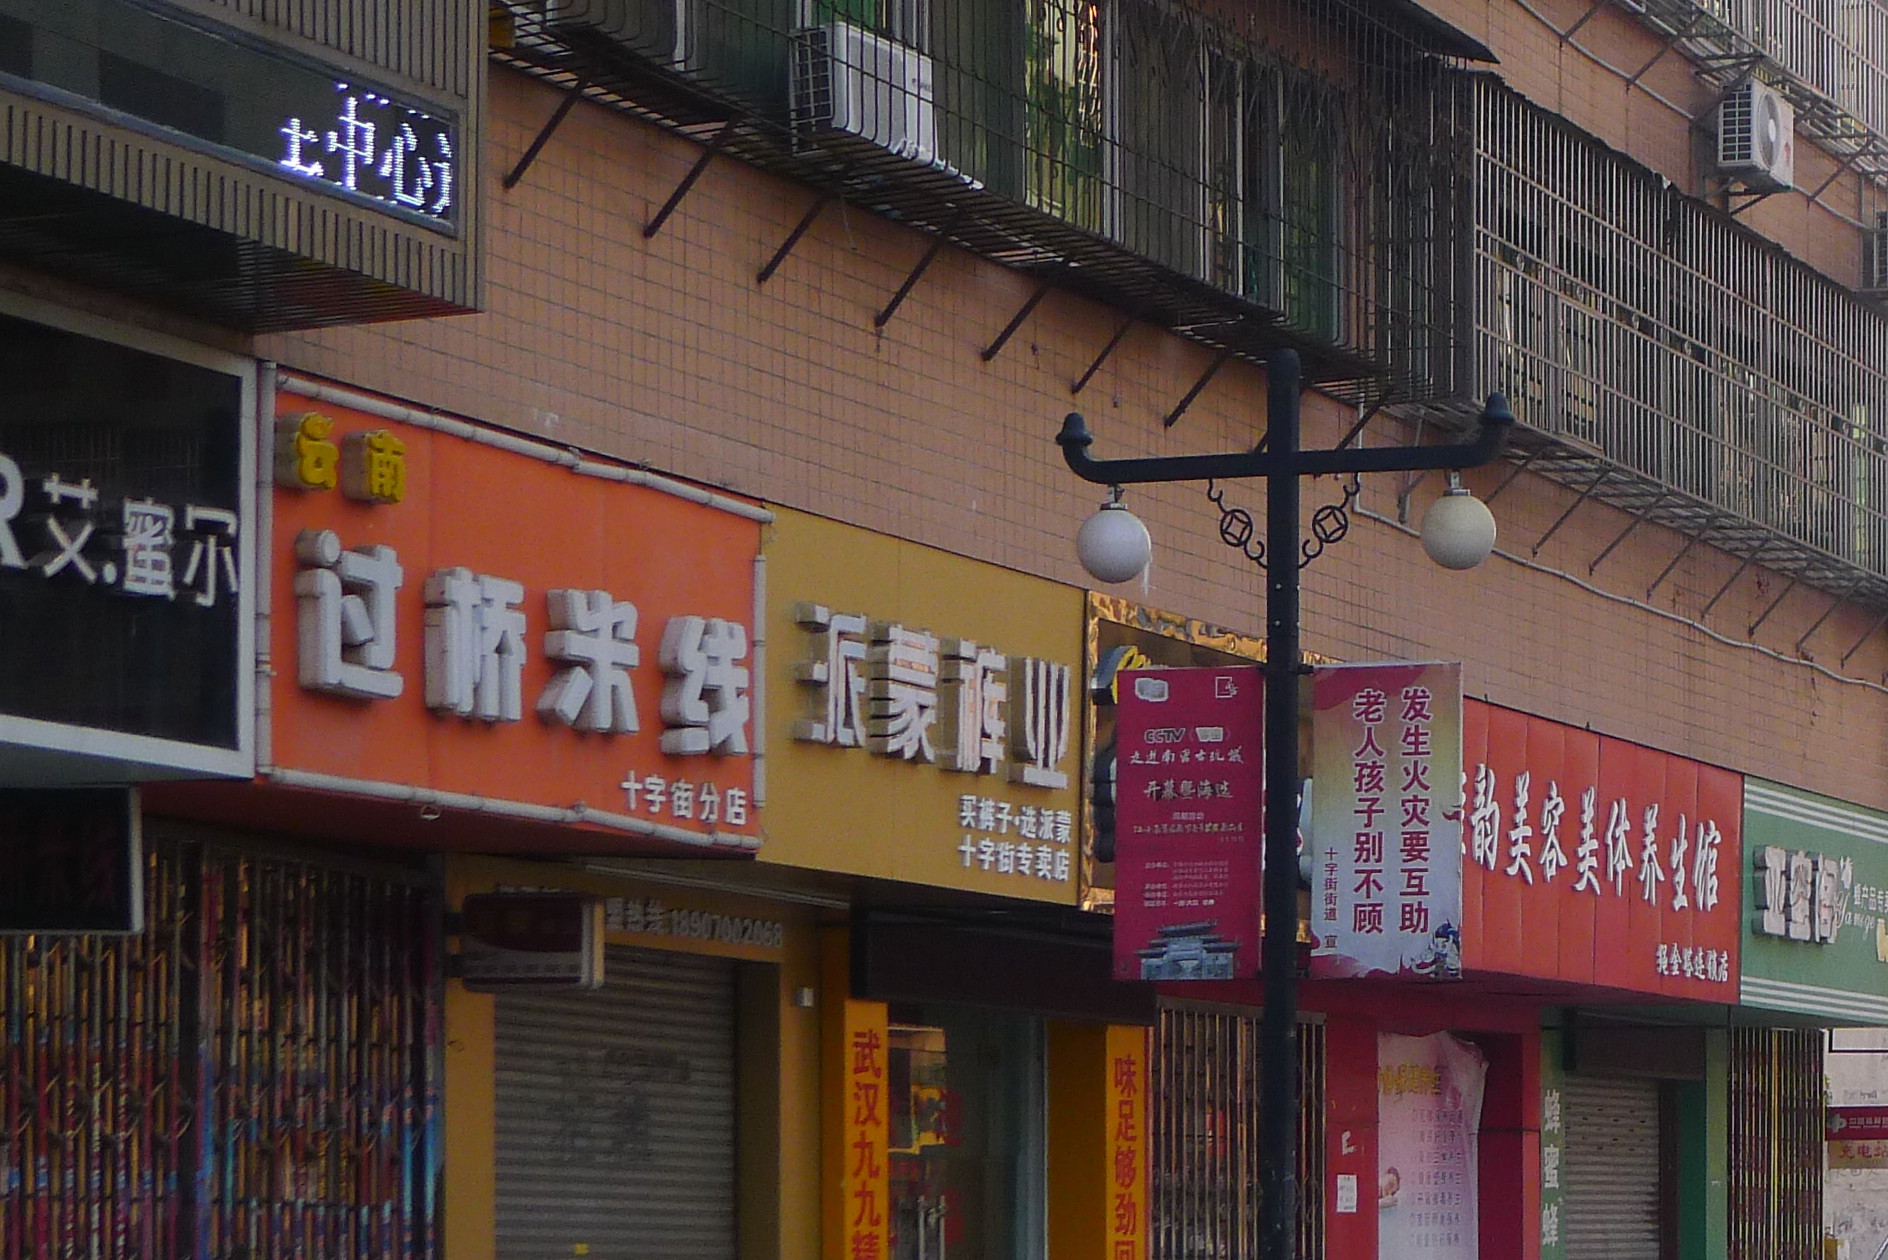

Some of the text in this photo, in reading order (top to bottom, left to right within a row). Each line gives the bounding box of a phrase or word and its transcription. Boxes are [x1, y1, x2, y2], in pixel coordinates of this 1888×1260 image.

[296, 529, 750, 756] 过桥米线
[797, 602, 1071, 790] 派蒙裤业
[621, 770, 747, 826] 十字街分店
[957, 834, 1071, 882] 十字街专卖店
[1352, 687, 1387, 935] 老人孩子别不顾
[1399, 687, 1432, 935] 发生火灾要互助
[1462, 763, 1724, 913] 韵美容美体养生馆
[1323, 847, 1339, 922] 十字街街道
